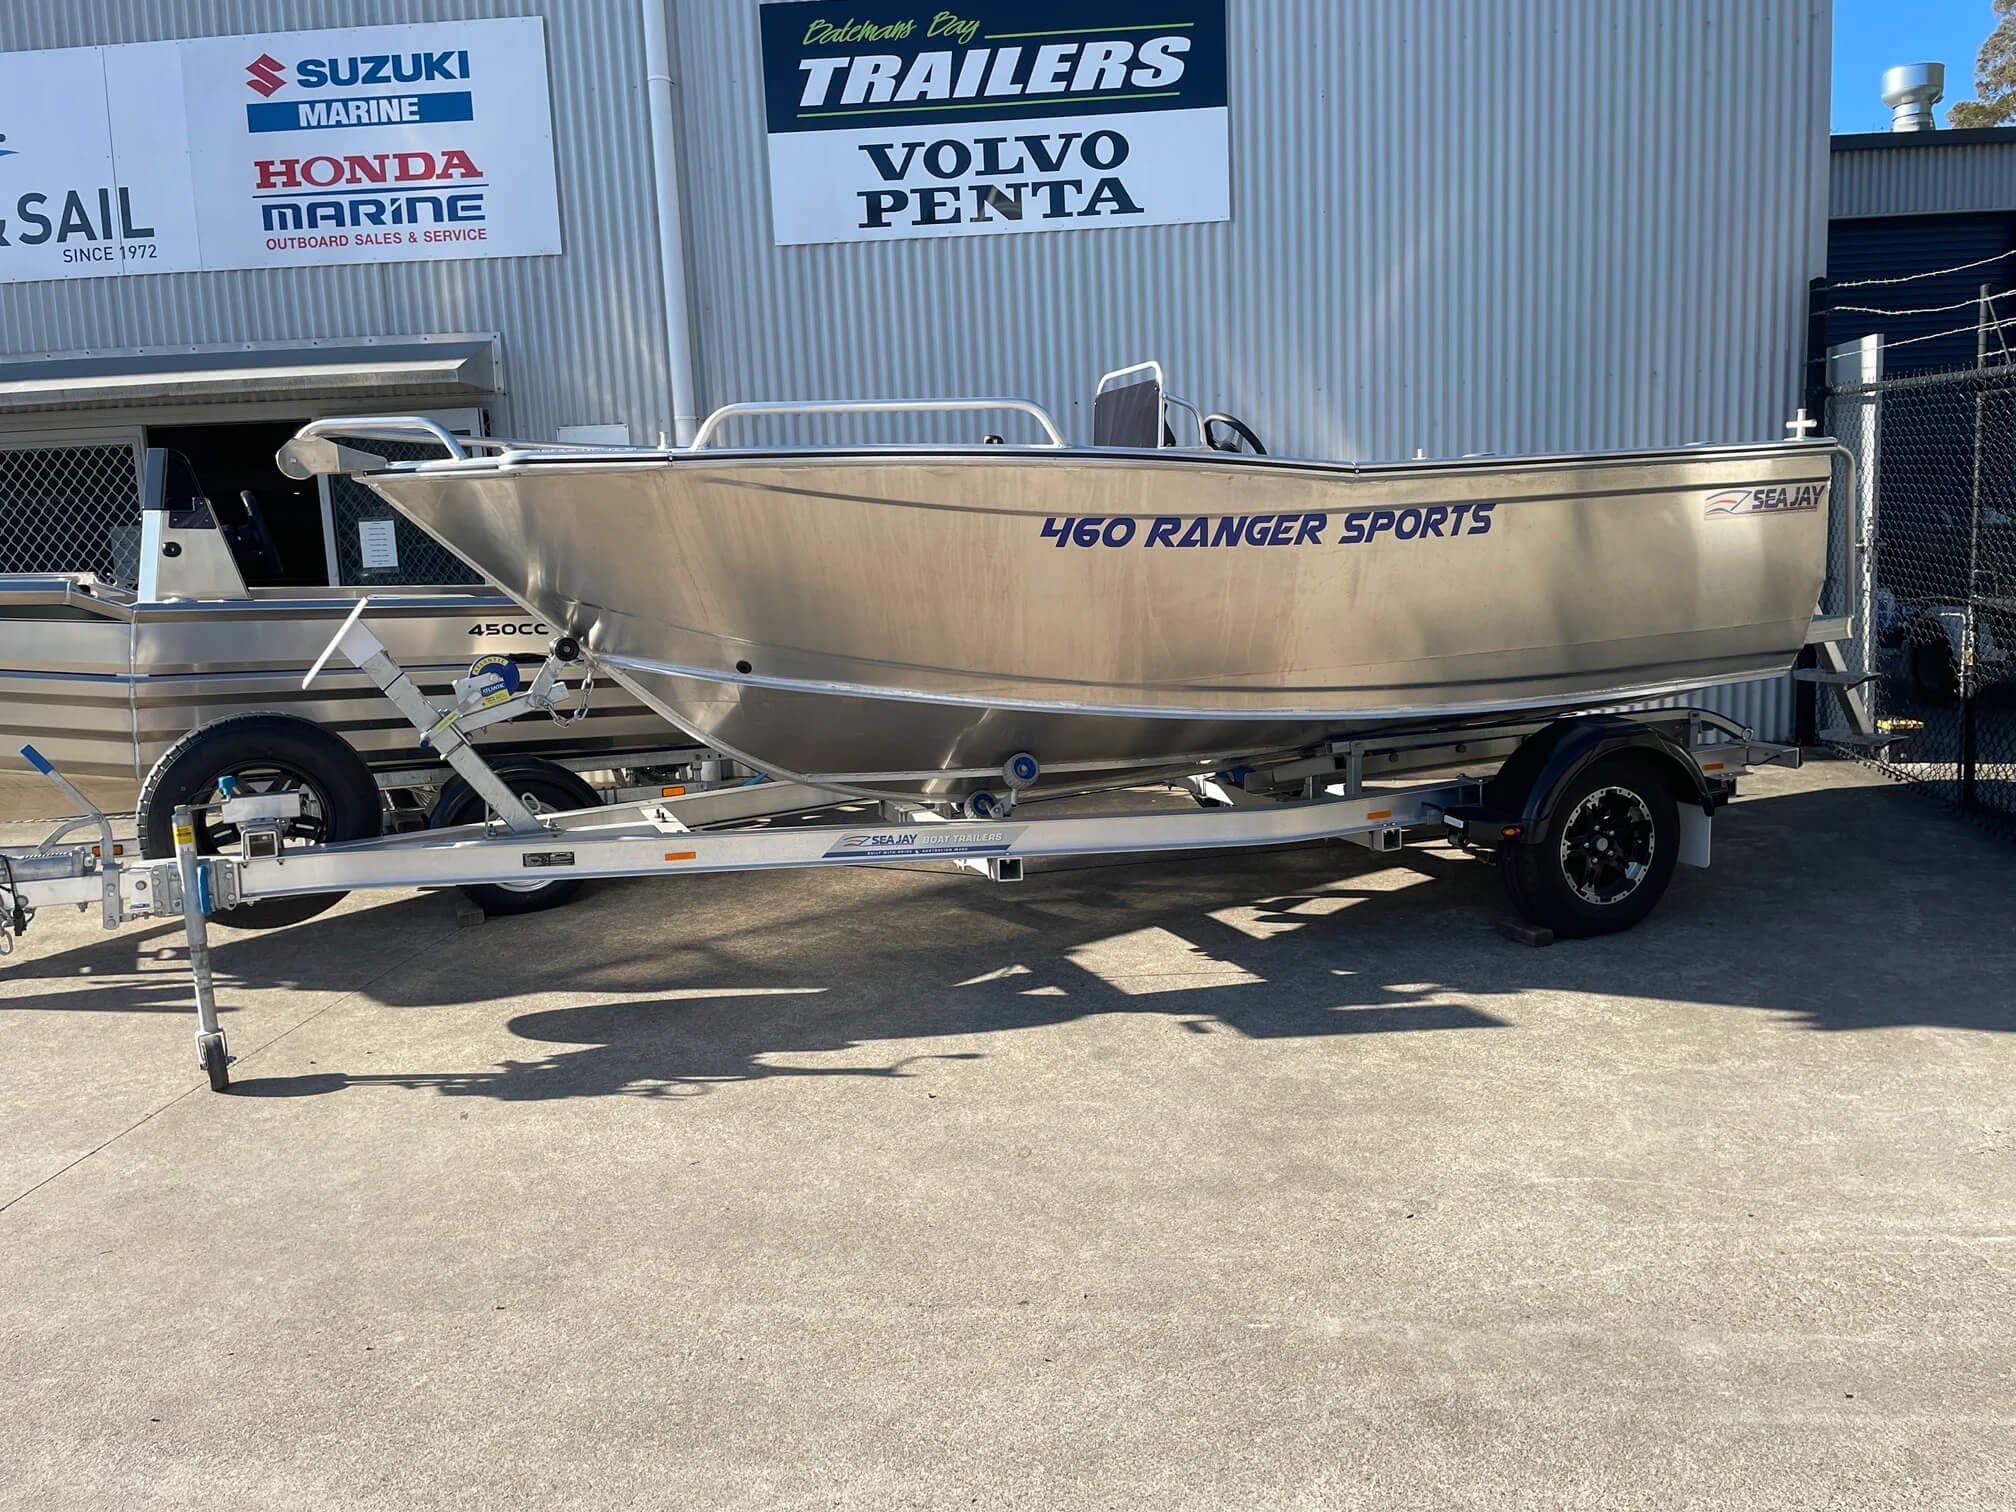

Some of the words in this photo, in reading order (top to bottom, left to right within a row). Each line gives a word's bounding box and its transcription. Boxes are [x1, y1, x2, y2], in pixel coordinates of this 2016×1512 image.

[802, 17, 918, 45] Batemans
[926, 10, 981, 45] Bay
[296, 50, 470, 88] SUZUKI
[799, 35, 1192, 107] TRAILERS
[298, 97, 420, 127] MARINE
[253, 150, 484, 189] HONDA
[858, 130, 1130, 181] VOLVO
[261, 193, 486, 231] MARINE
[856, 177, 1145, 229] PENTA
[63, 246, 114, 263] SINCE
[119, 244, 158, 259] 1972
[266, 234, 349, 250] OUTBOARD
[354, 231, 402, 246] SALES
[408, 231, 418, 243] &
[423, 228, 487, 243] SERVICE
[1040, 516, 1137, 548] 460
[1143, 513, 1328, 548] RANGER
[1337, 503, 1497, 545] SPORTS
[922, 834, 951, 844] BOAT
[953, 832, 1003, 843] TRAILERS
